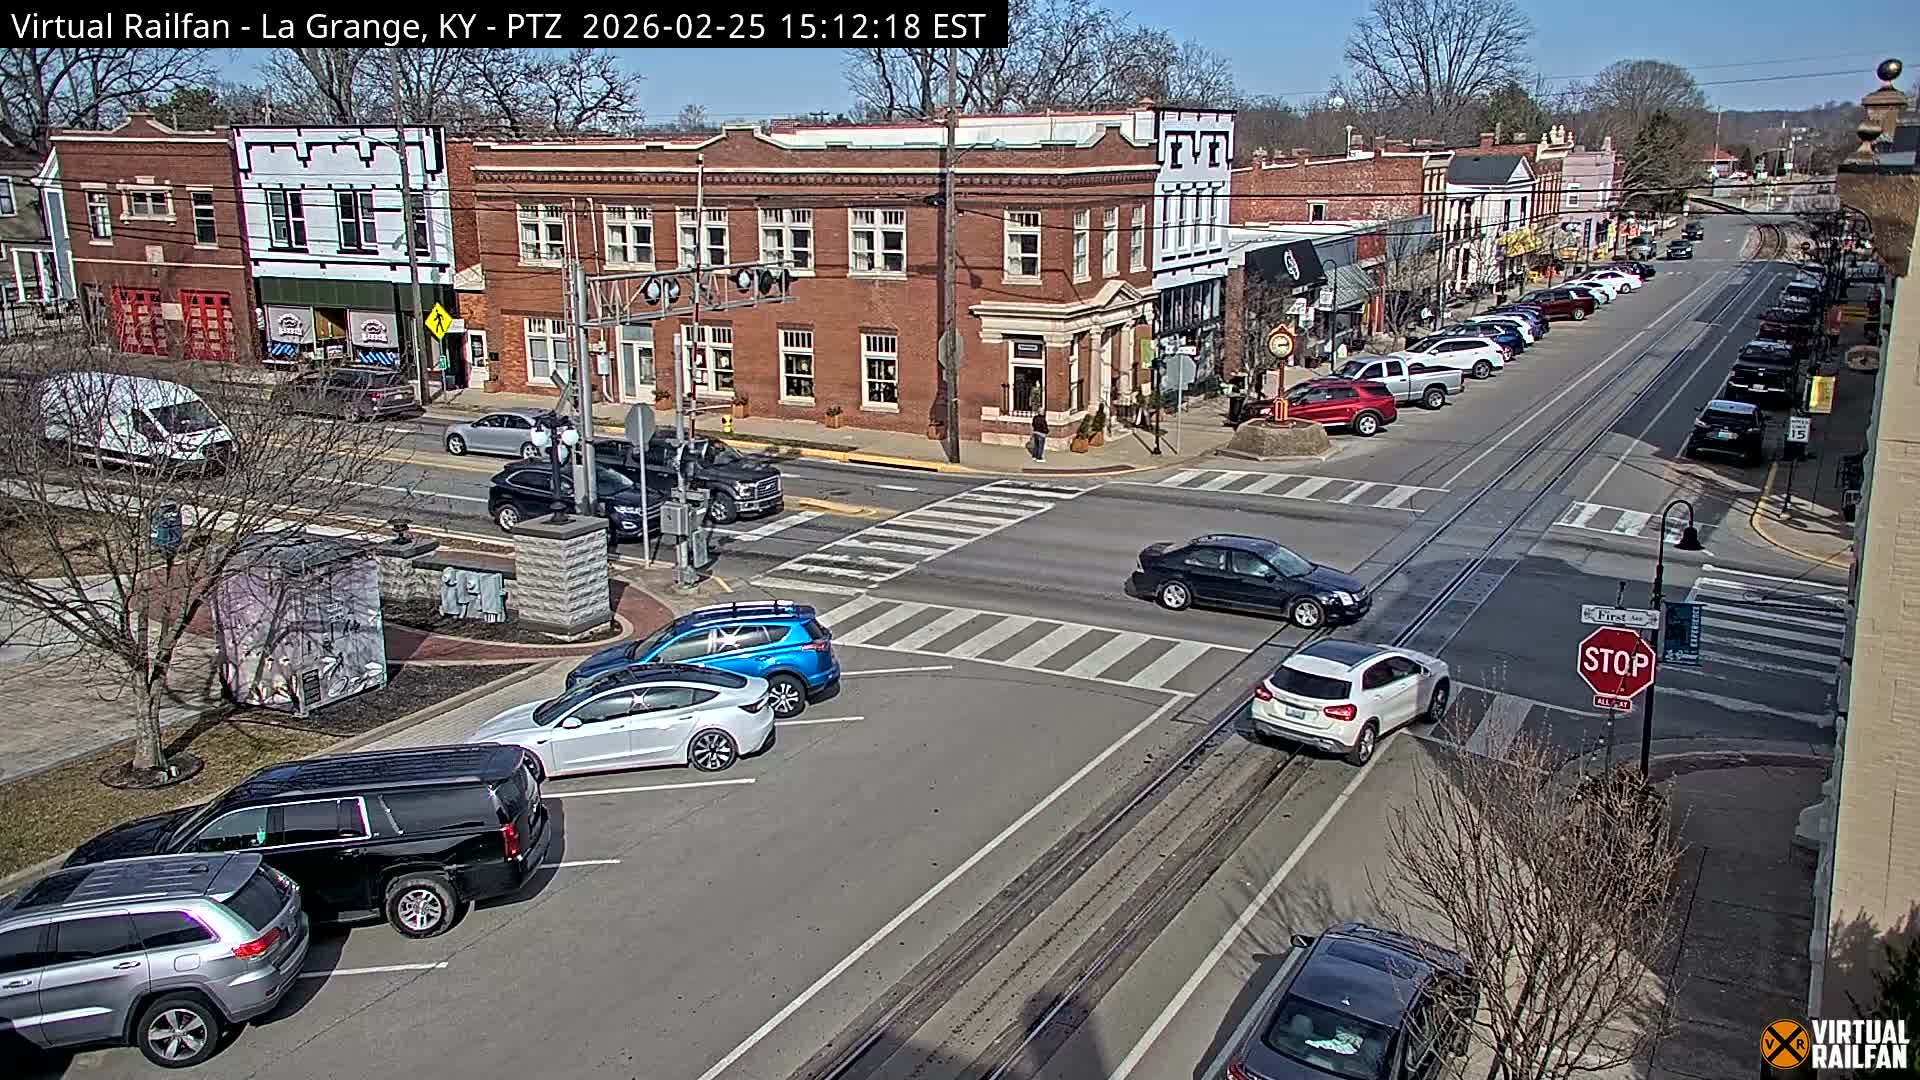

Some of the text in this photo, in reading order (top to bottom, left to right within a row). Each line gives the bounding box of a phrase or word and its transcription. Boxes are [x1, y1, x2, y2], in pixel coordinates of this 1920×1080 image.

[1792, 430, 1806, 439] 15
[1598, 610, 1626, 622] First
[1583, 646, 1649, 678] STOP
[1597, 698, 1610, 706] ALL
